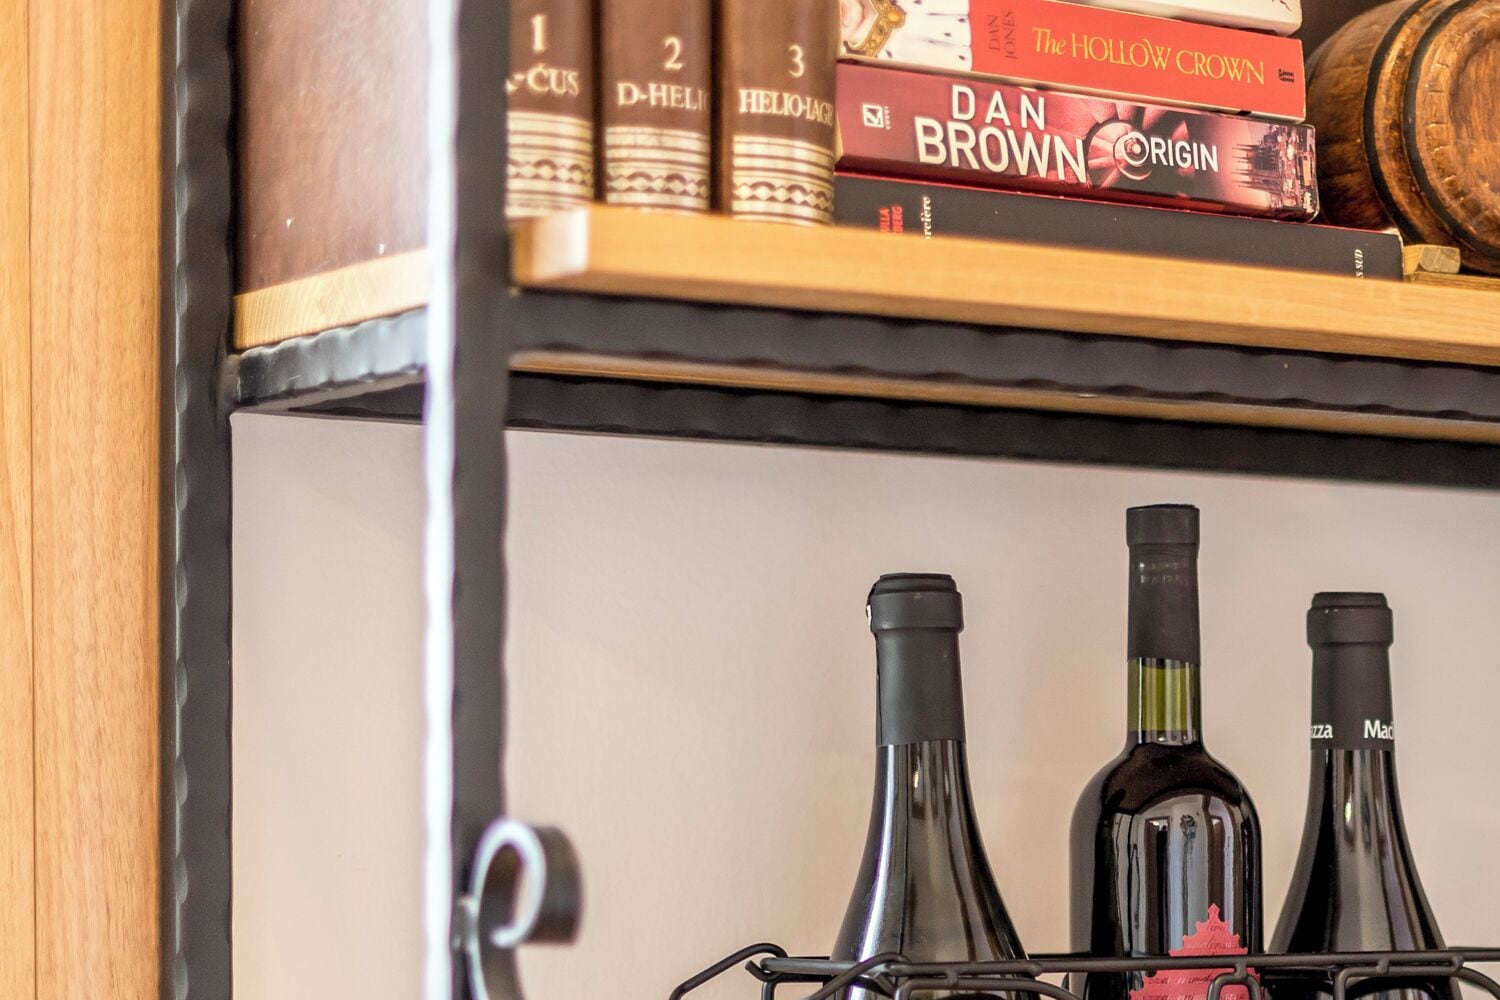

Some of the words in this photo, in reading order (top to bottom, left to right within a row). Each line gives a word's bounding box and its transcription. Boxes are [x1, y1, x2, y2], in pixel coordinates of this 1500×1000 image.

[531, 13, 547, 53] 1
[664, 36, 683, 70] 2
[986, 14, 1000, 51] DAN
[788, 44, 805, 77] 3
[1032, 27, 1066, 56] The
[1071, 33, 1171, 71] HOLLOW
[1175, 50, 1265, 86] CROWN
[951, 84, 1045, 130] DAN
[914, 115, 1088, 184] BROWN
[1123, 131, 1220, 173] ORIGIN
